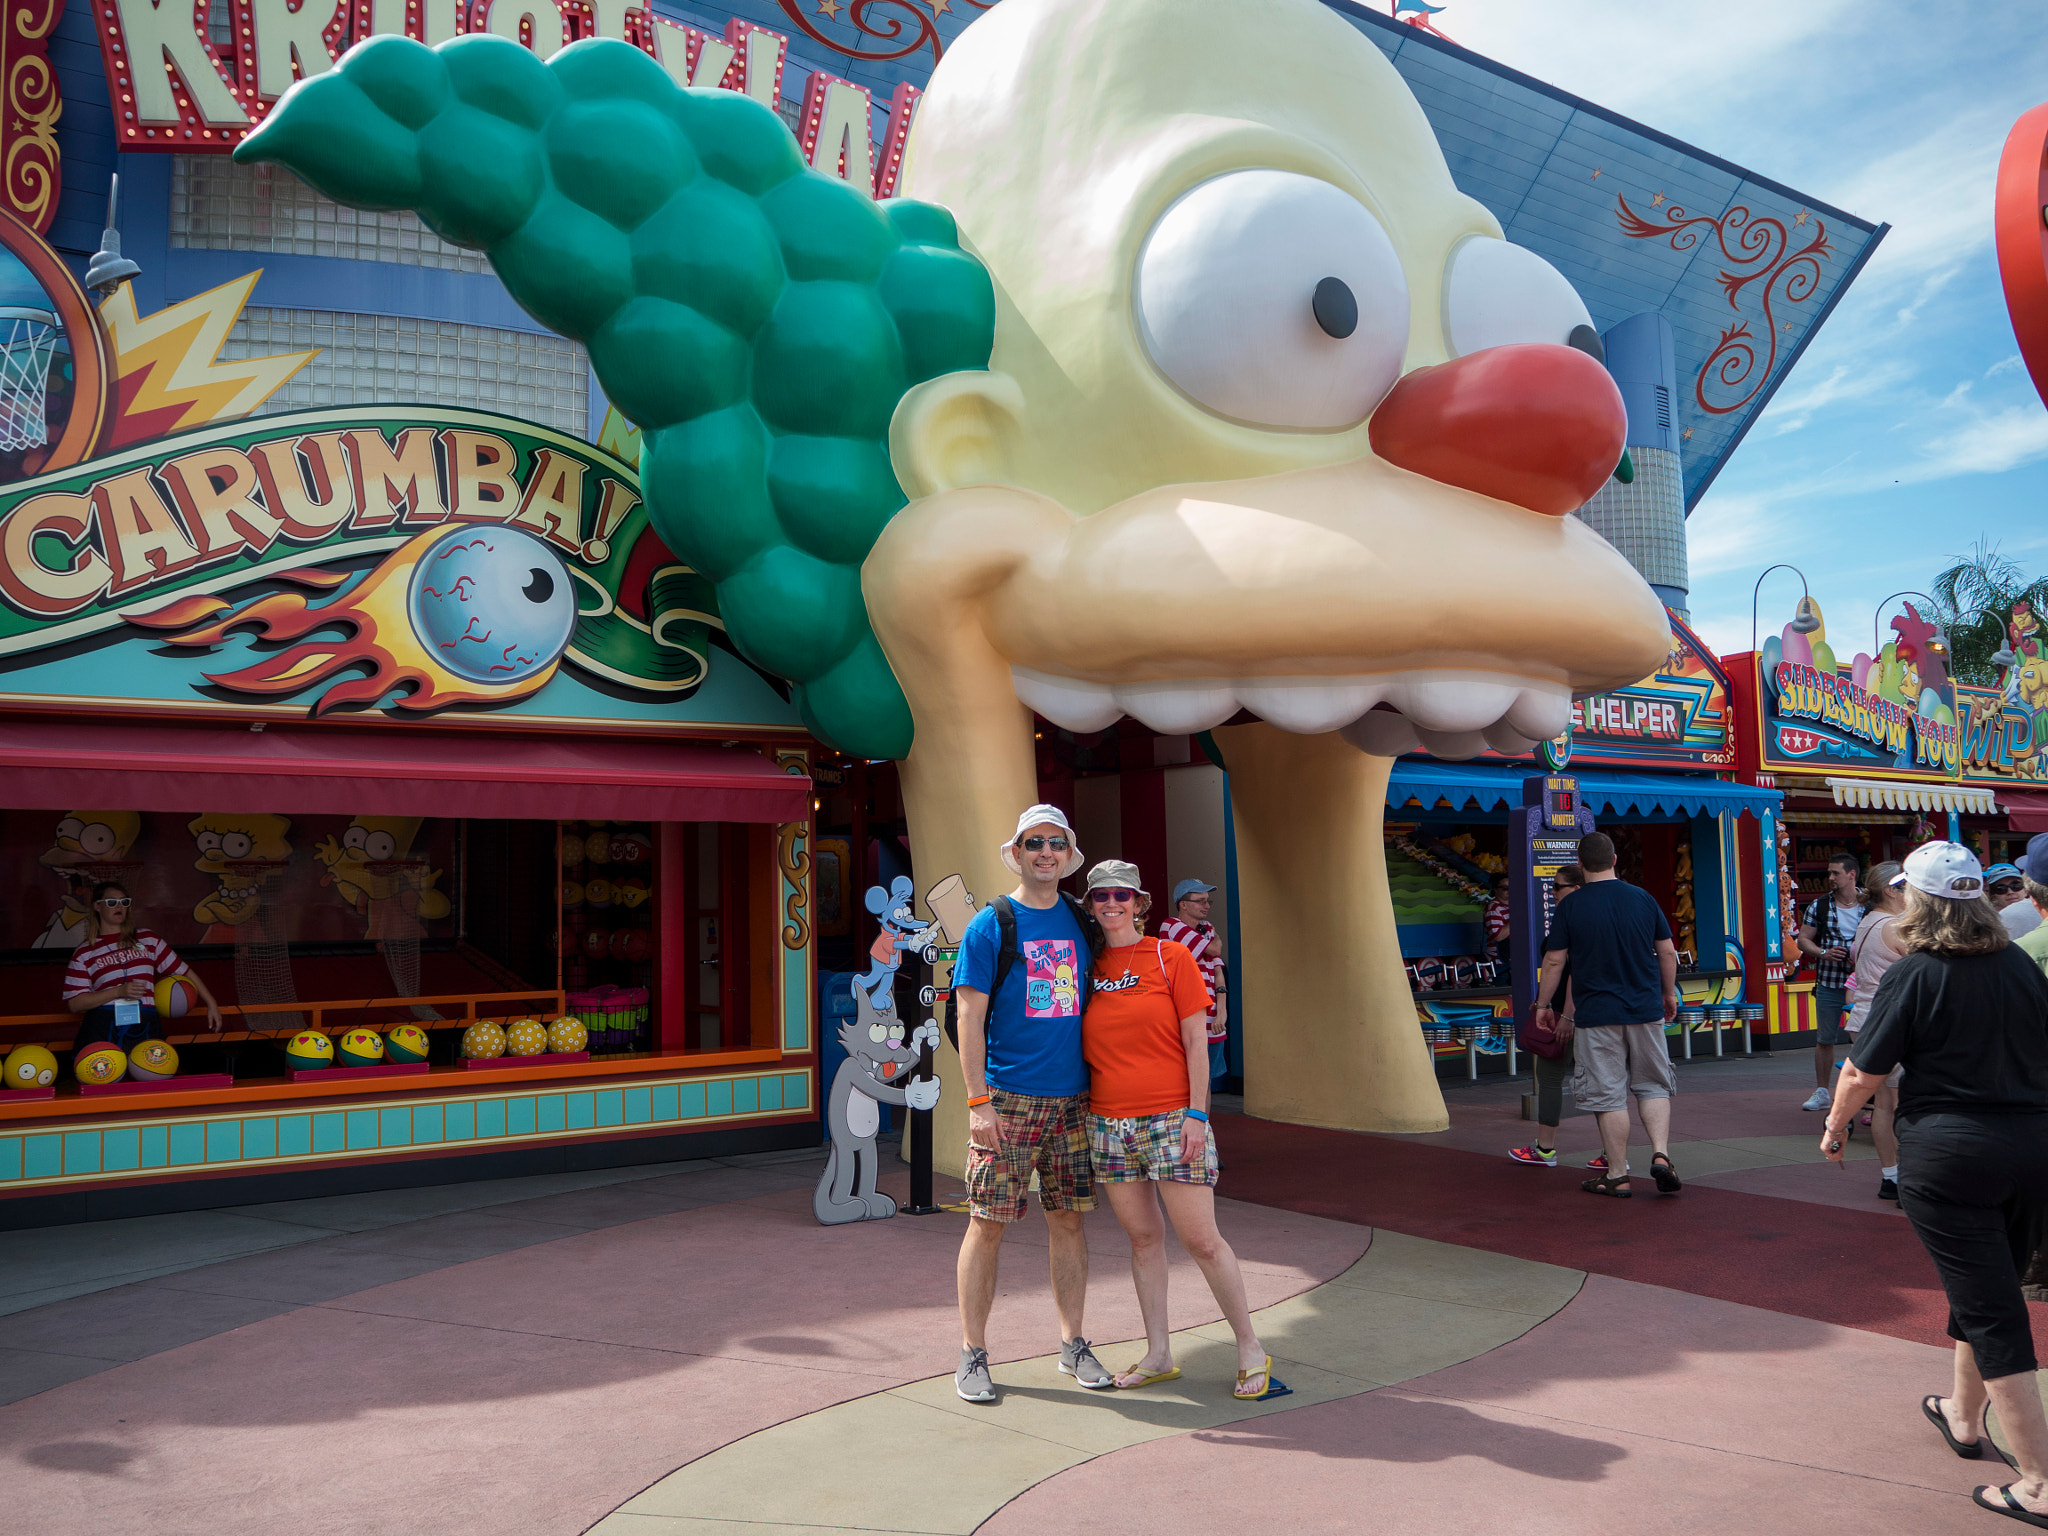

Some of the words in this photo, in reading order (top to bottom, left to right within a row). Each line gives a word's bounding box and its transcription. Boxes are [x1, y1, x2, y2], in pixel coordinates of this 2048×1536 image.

[0, 426, 643, 619] CARUMBA!
[1588, 696, 1678, 735] HELPER
[1776, 659, 1907, 757] SIDESHOW
[1910, 710, 1958, 770] YOU
[814, 767, 843, 785] TRANCE
[1547, 777, 1562, 791] WAIT
[1562, 778, 1576, 791] TIME
[1559, 793, 1571, 811] 10
[1551, 813, 1576, 827] MINUTES
[1545, 841, 1576, 849] WARNING!
[96, 949, 149, 969] SIDESHOW
